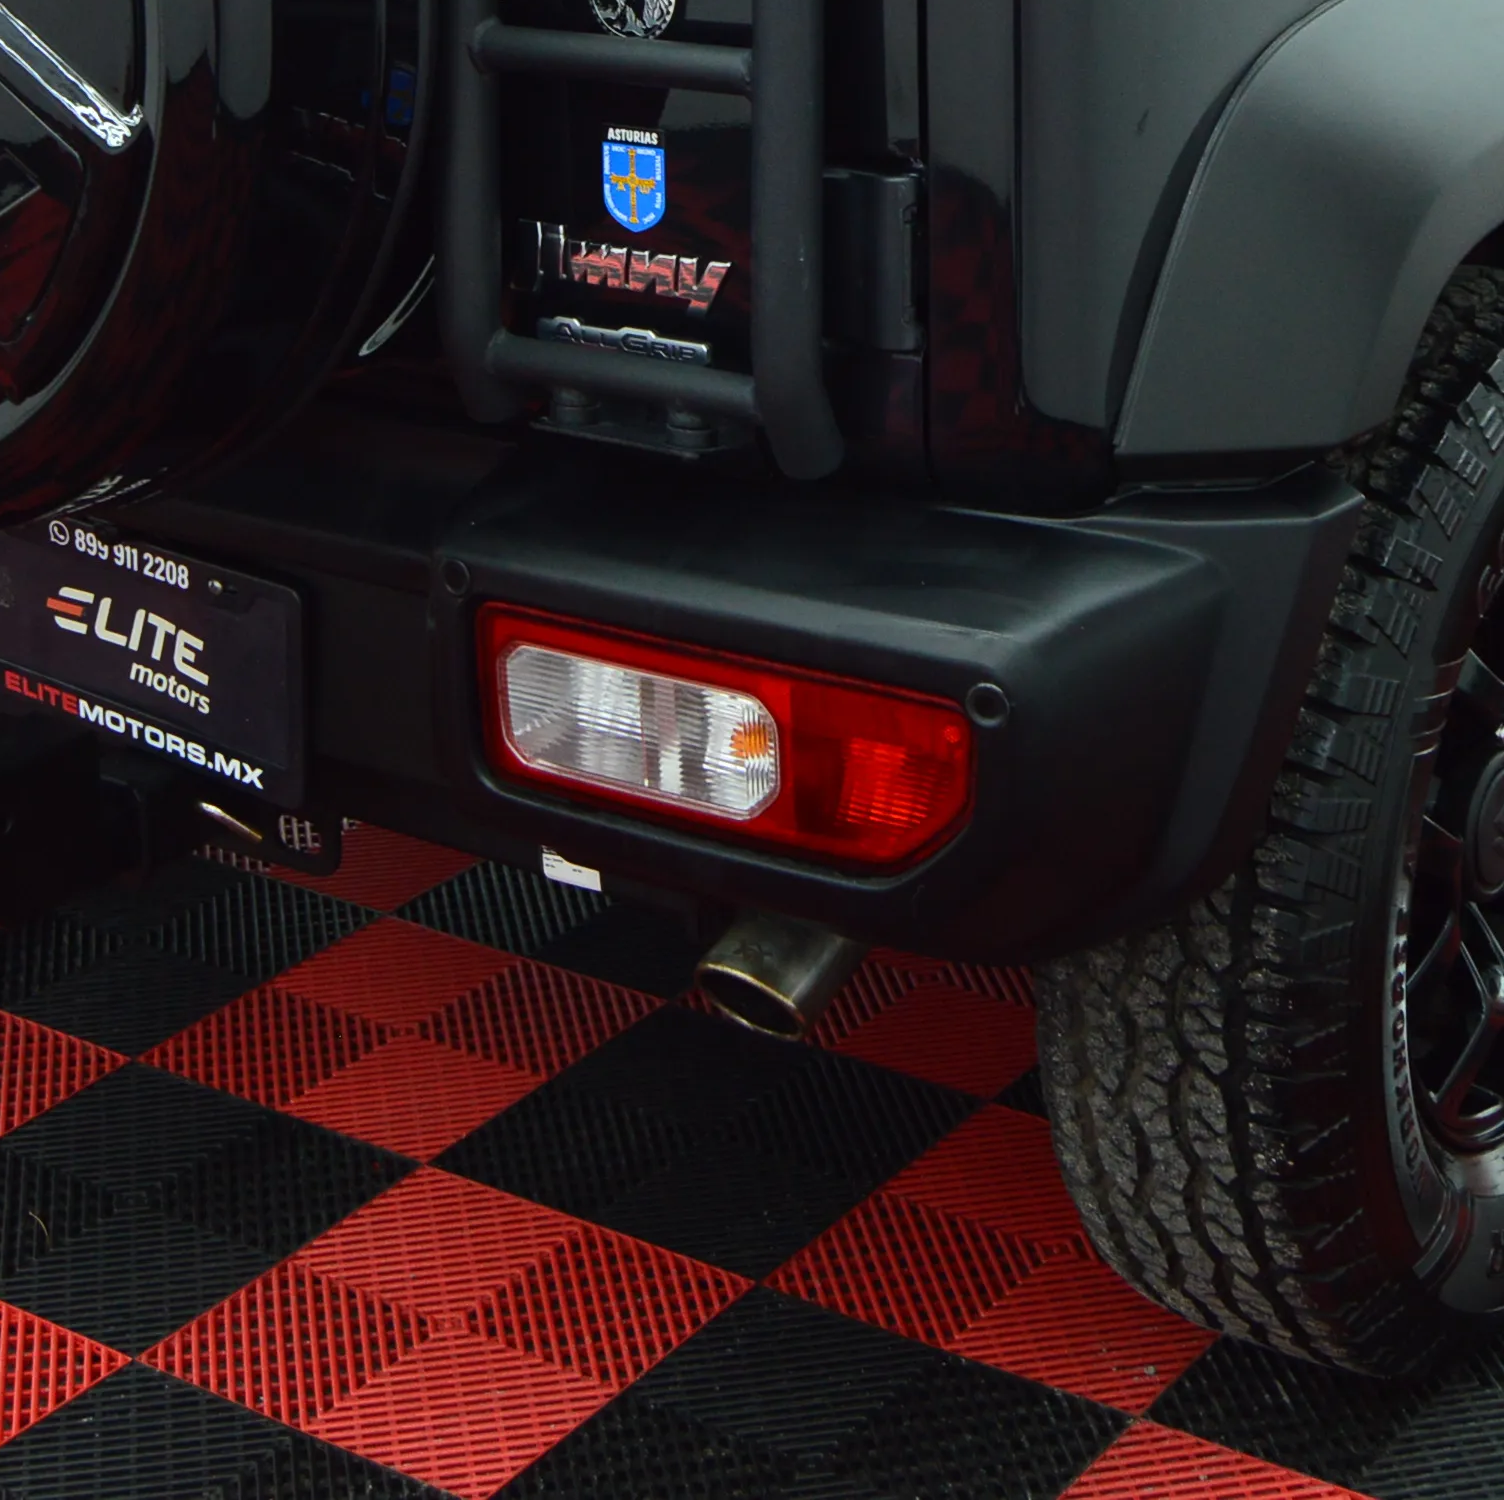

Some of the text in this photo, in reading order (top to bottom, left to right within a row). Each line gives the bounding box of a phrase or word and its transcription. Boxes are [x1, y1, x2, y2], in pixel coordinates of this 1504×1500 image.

[607, 127, 659, 145] ASTURIAS
[74, 528, 190, 590] 899 911 2208
[46, 586, 209, 687] ELITE
[129, 661, 210, 714] motors
[4, 670, 264, 790] ELITEMOTORS.MX
